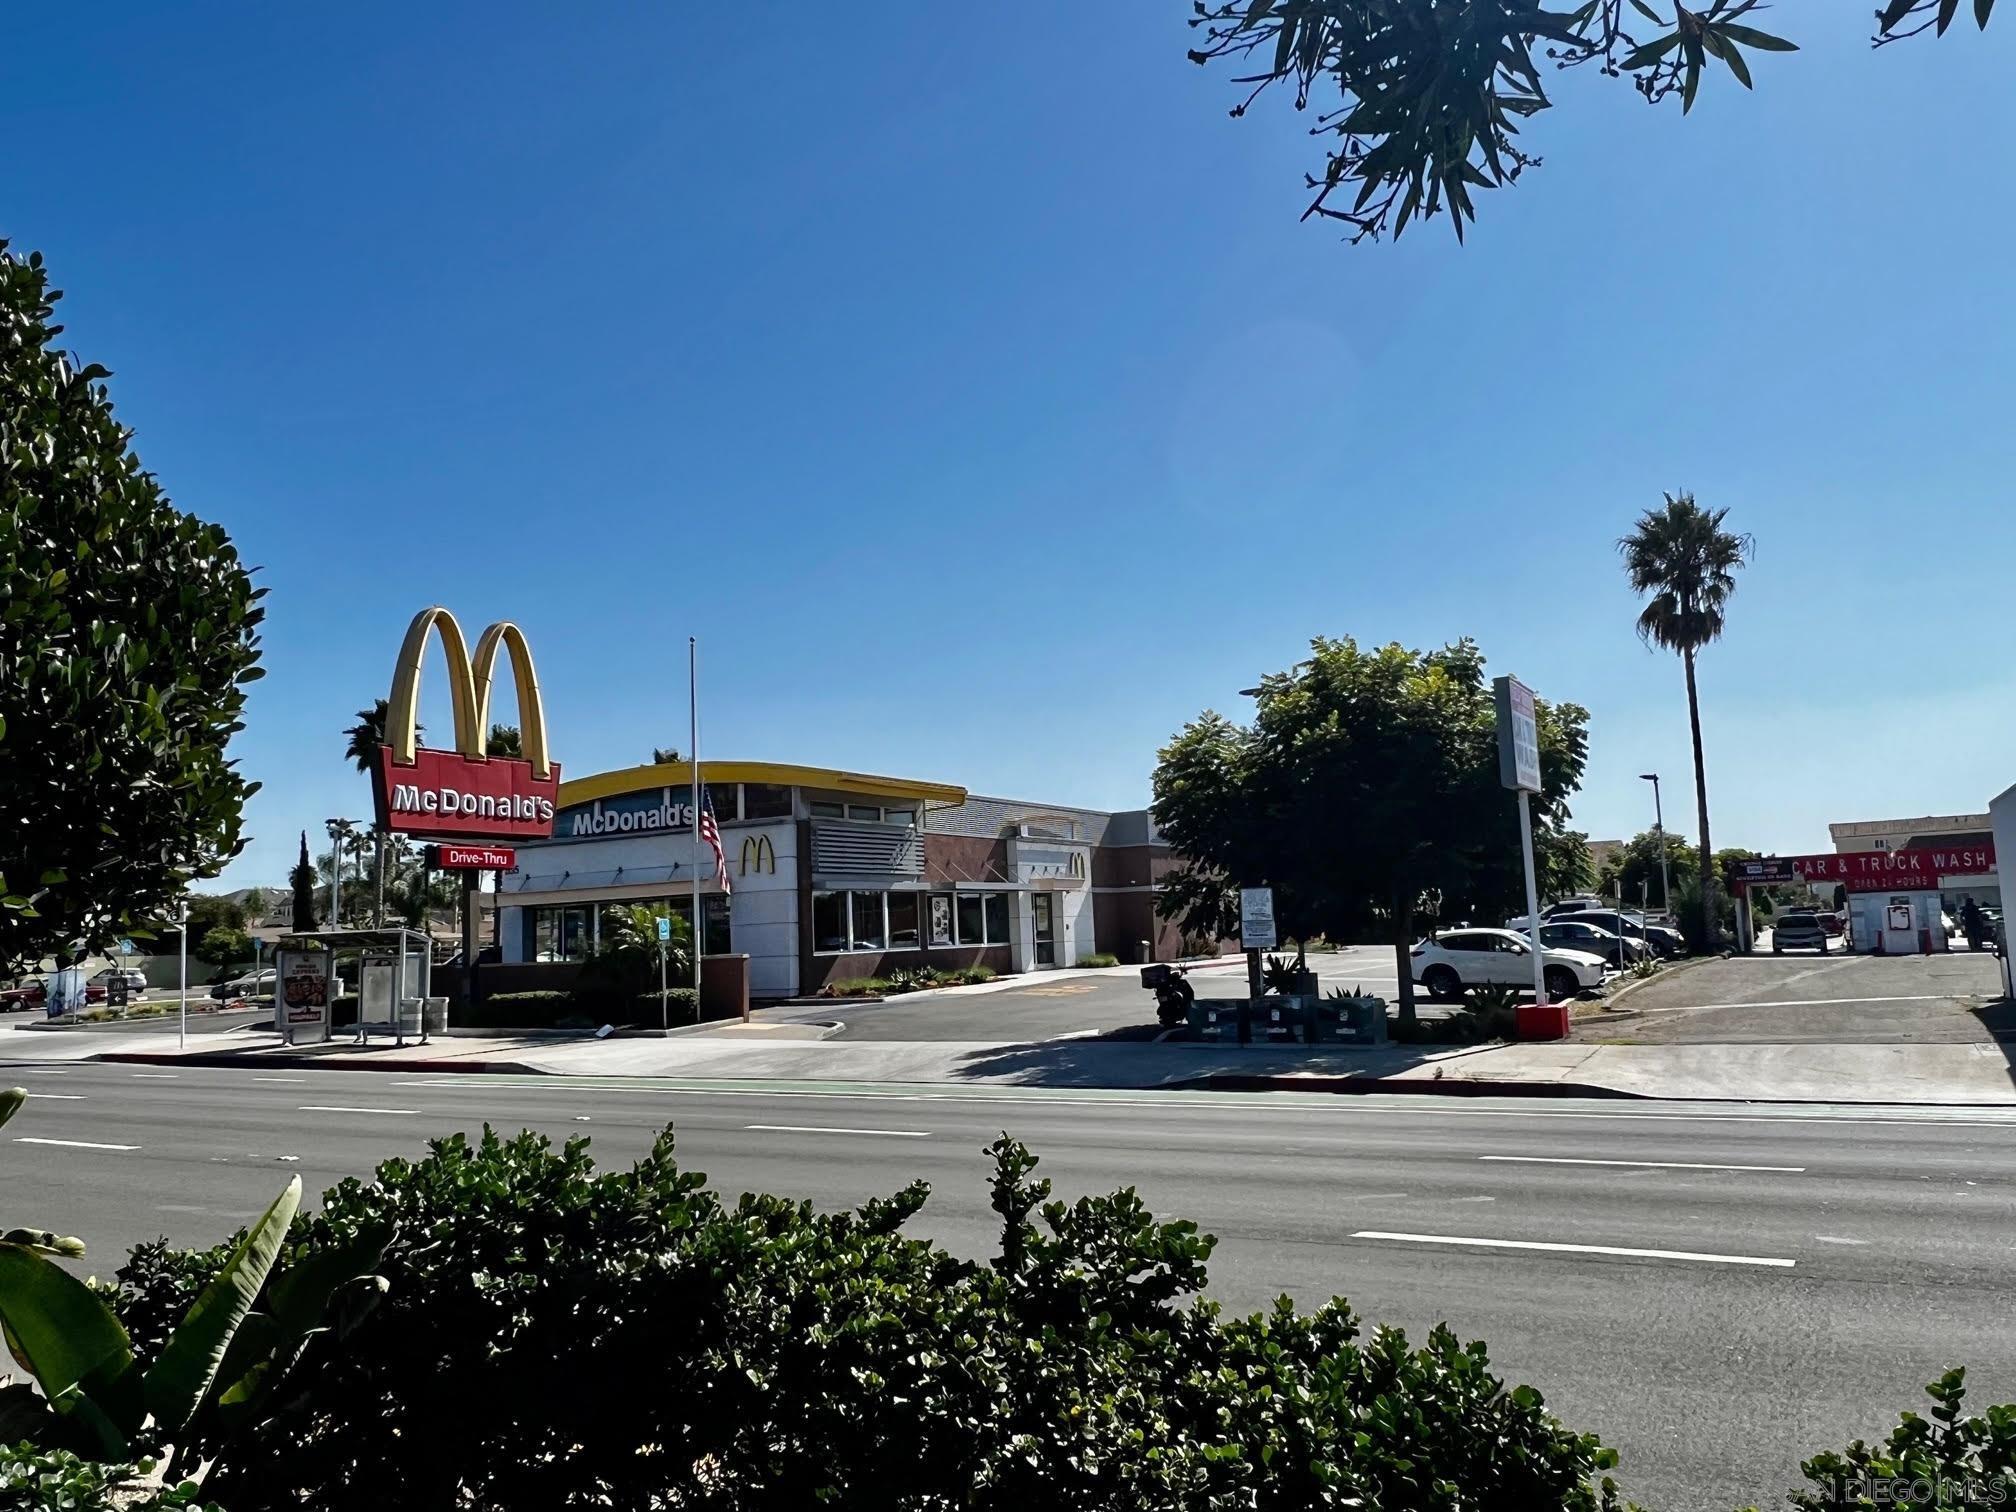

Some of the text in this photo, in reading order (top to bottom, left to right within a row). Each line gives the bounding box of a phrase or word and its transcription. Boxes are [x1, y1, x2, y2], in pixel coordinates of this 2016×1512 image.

[392, 784, 553, 819] McDonald's
[572, 803, 696, 835] McDonald's
[450, 850, 508, 865] Drive-Thru
[1792, 860, 1827, 875] CAR
[1839, 859, 1848, 873] &
[1860, 855, 1921, 872] TRUCK
[1932, 851, 1986, 868] WASH
